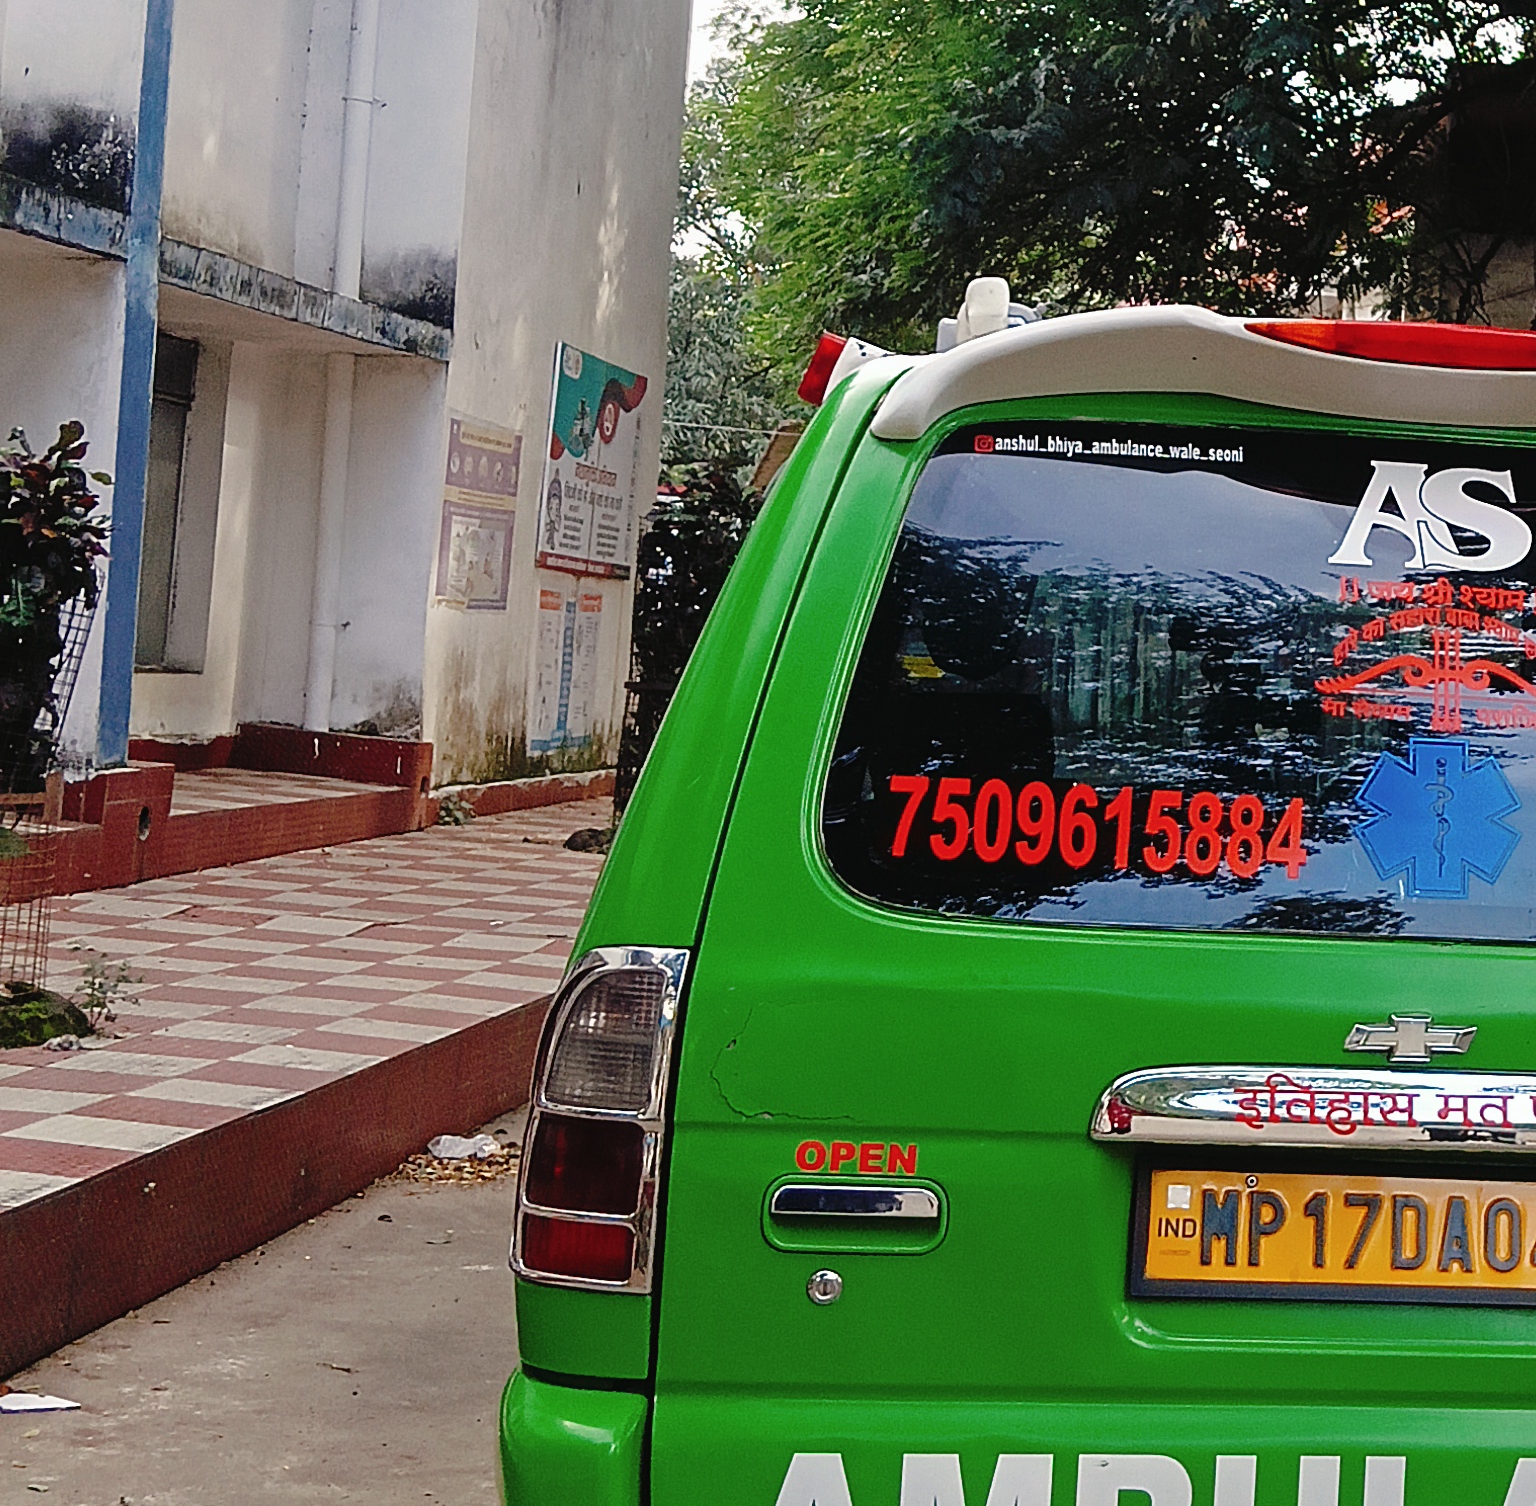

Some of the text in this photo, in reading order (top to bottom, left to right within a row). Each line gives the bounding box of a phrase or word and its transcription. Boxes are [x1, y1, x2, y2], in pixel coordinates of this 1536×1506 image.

[994, 435, 1244, 463] anshul_bhiya_ambulance_wale_seoni
[1327, 460, 1532, 572] AS
[1367, 581, 1415, 603] जय
[1423, 577, 1453, 604] श्री
[1460, 585, 1527, 611] श्याम
[1390, 608, 1440, 630] सहारा
[886, 775, 1307, 879] 7509615884
[1236, 1074, 1419, 1135] इतिहास
[1437, 1094, 1512, 1128] मत
[796, 1140, 917, 1174] OPEN
[1158, 1217, 1197, 1238] IND
